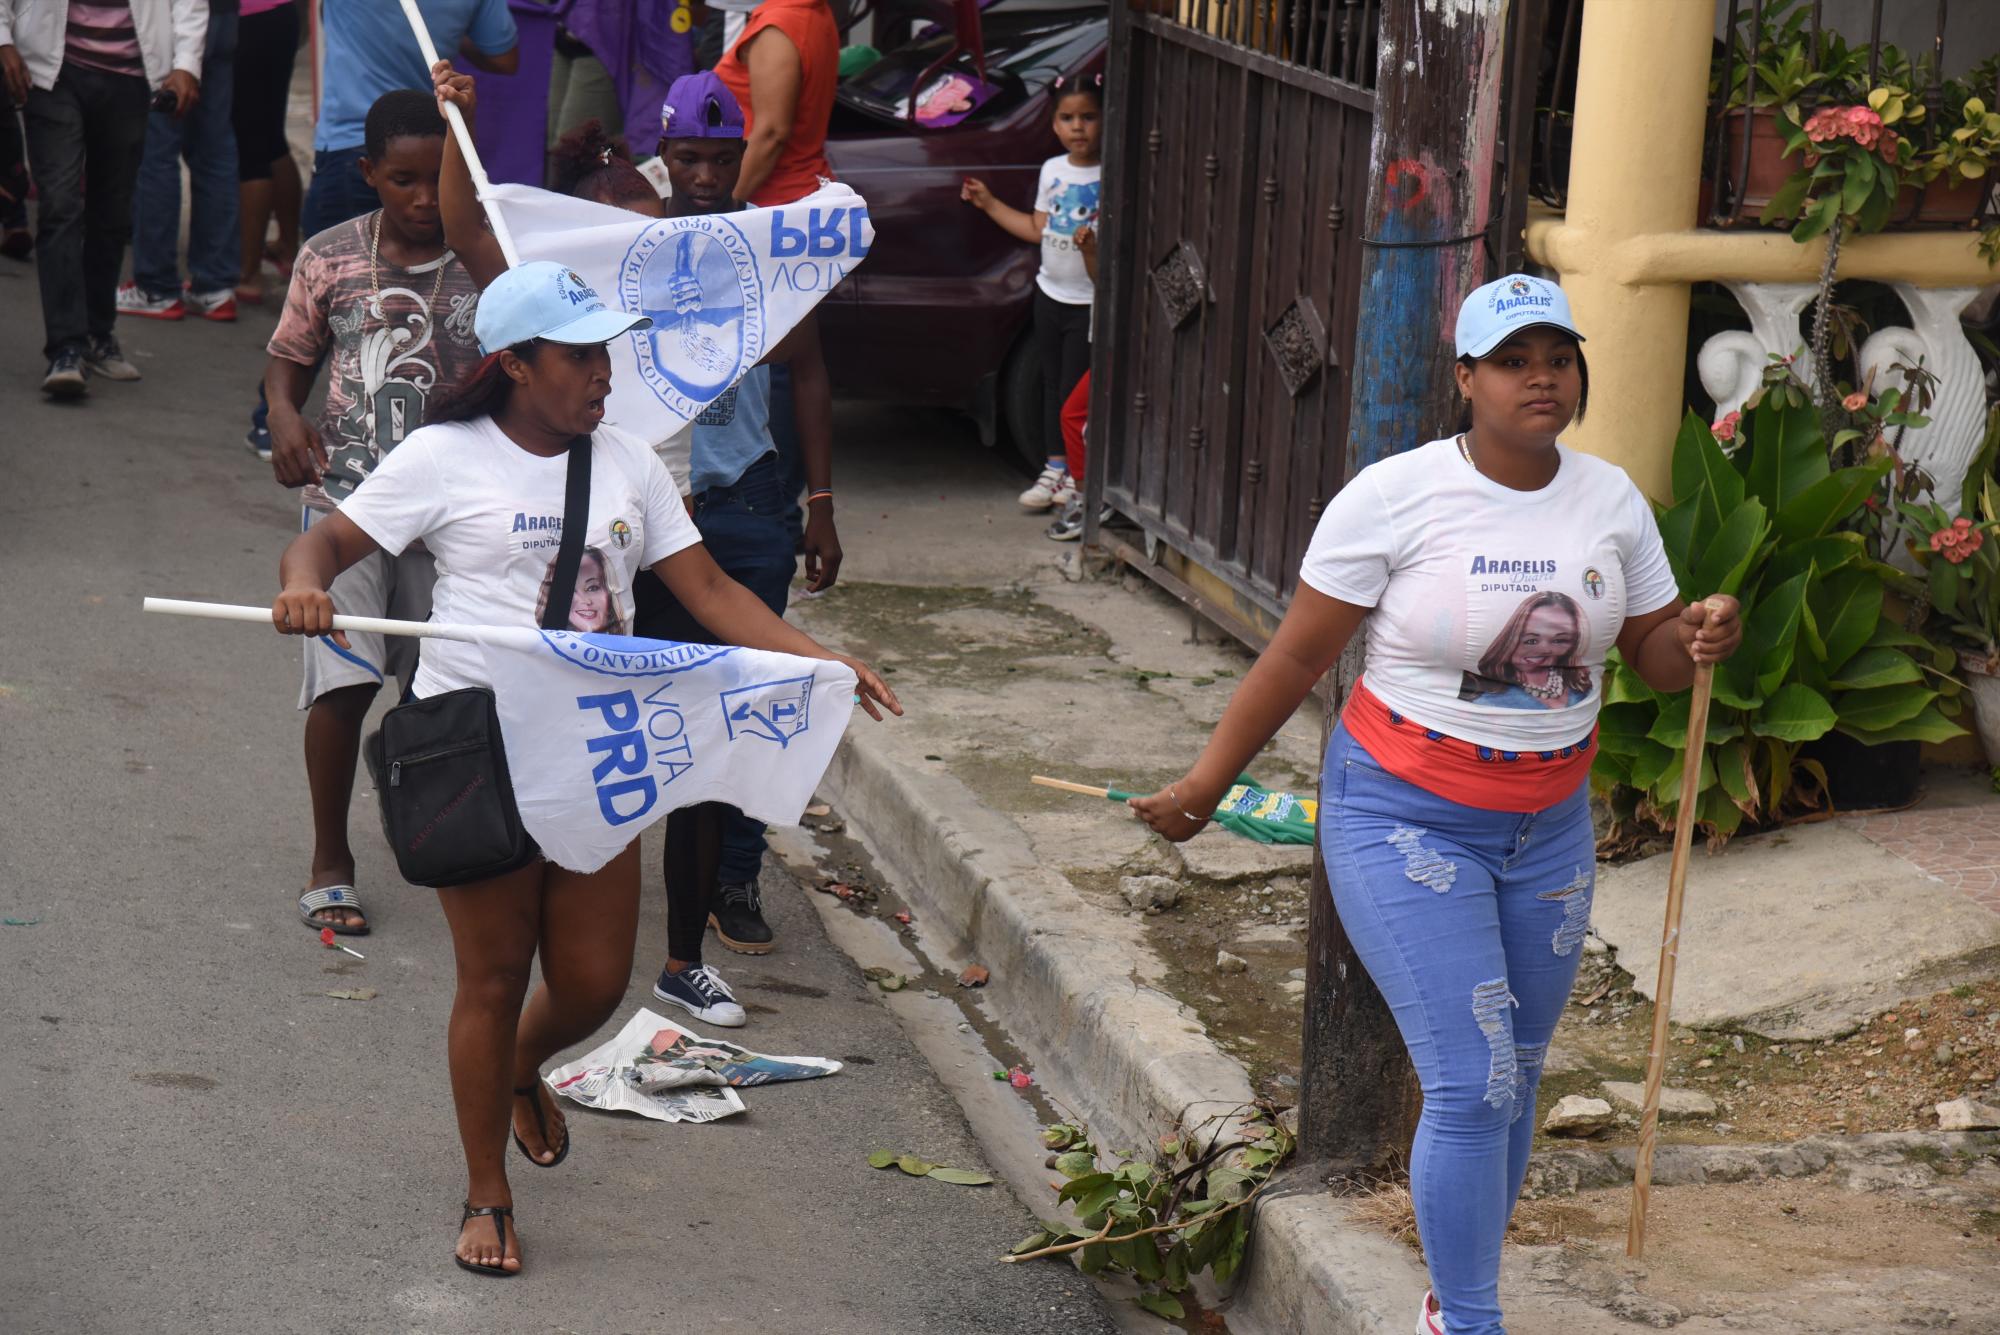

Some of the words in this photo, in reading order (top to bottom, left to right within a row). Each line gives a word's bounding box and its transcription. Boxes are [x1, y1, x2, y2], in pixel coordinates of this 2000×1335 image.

[1496, 295, 1551, 315] ARACELIS
[1505, 310, 1547, 321] DIPUTADA
[512, 512, 563, 533] ARACE
[522, 539, 561, 550] DIPUTAD
[1470, 555, 1557, 575] ARACELIS
[1481, 583, 1537, 593] DIPUTADA
[772, 703, 797, 722] 1
[643, 681, 694, 786] VOTA
[576, 689, 658, 826] PRD
